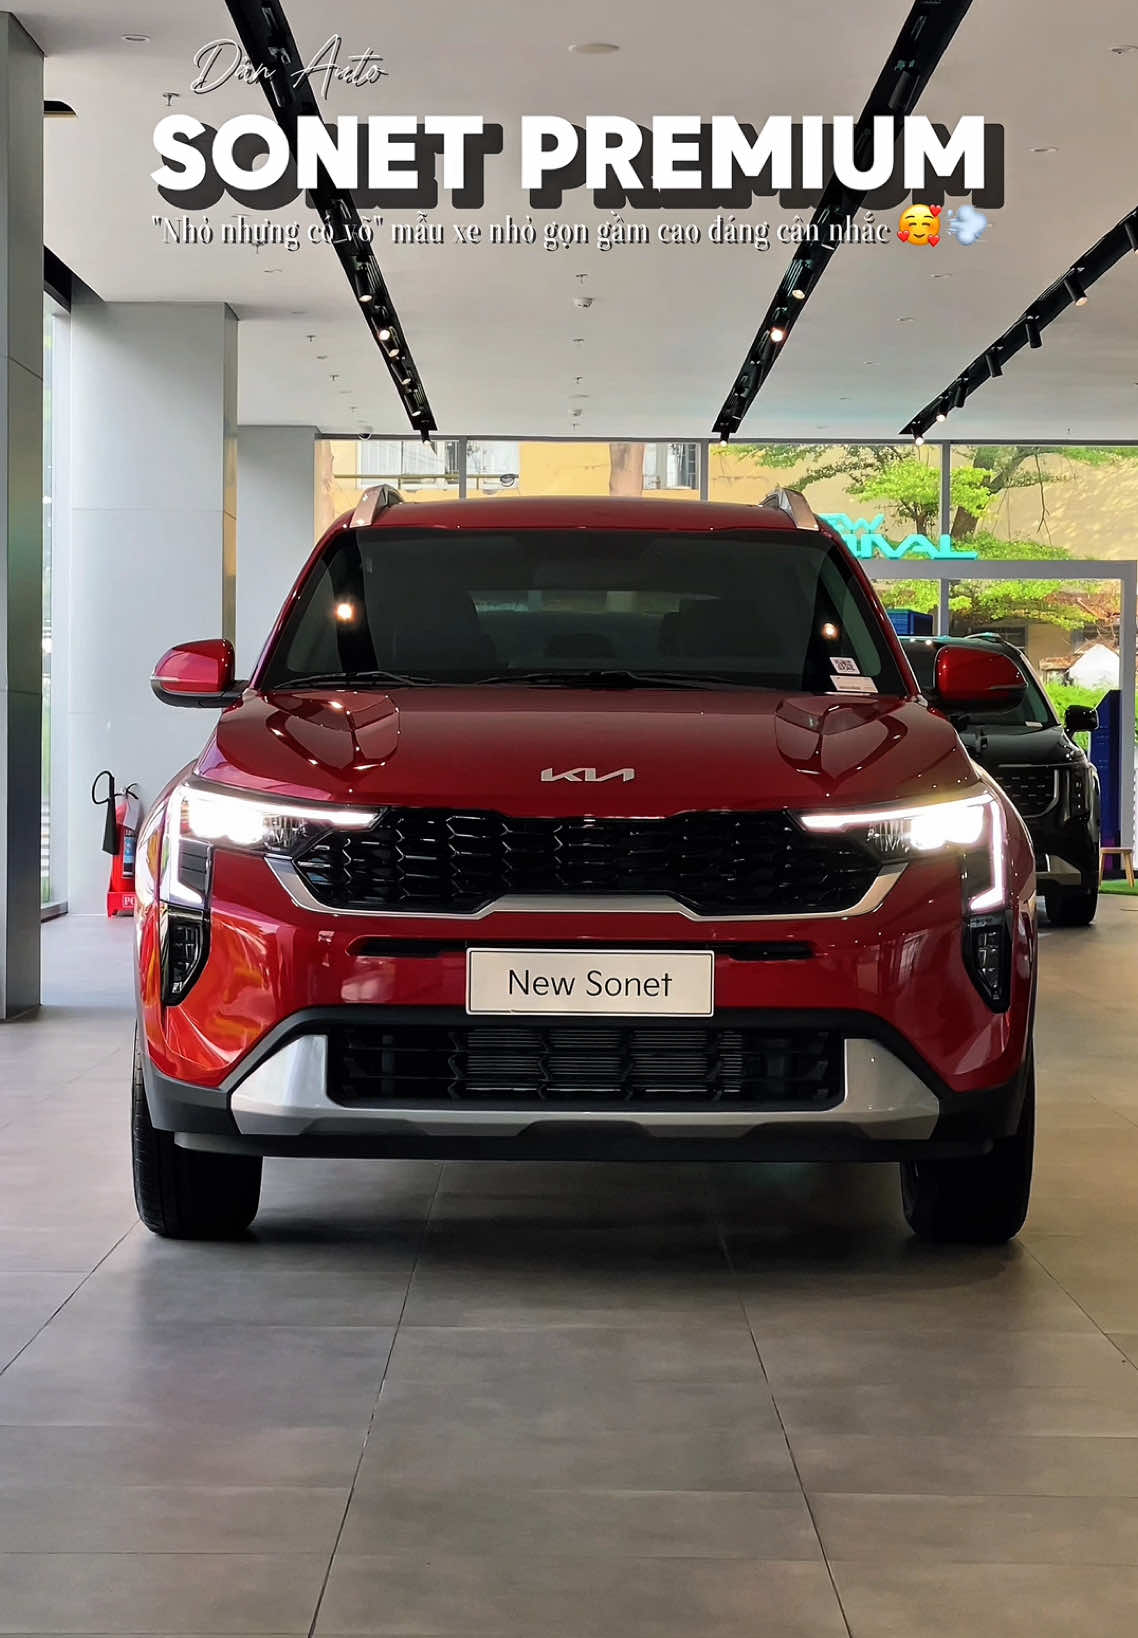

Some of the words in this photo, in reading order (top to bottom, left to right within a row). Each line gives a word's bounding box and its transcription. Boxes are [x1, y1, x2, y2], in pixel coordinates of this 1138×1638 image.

[540, 767, 636, 782] KIA
[508, 969, 576, 996] New
[585, 969, 673, 997] Sonet
